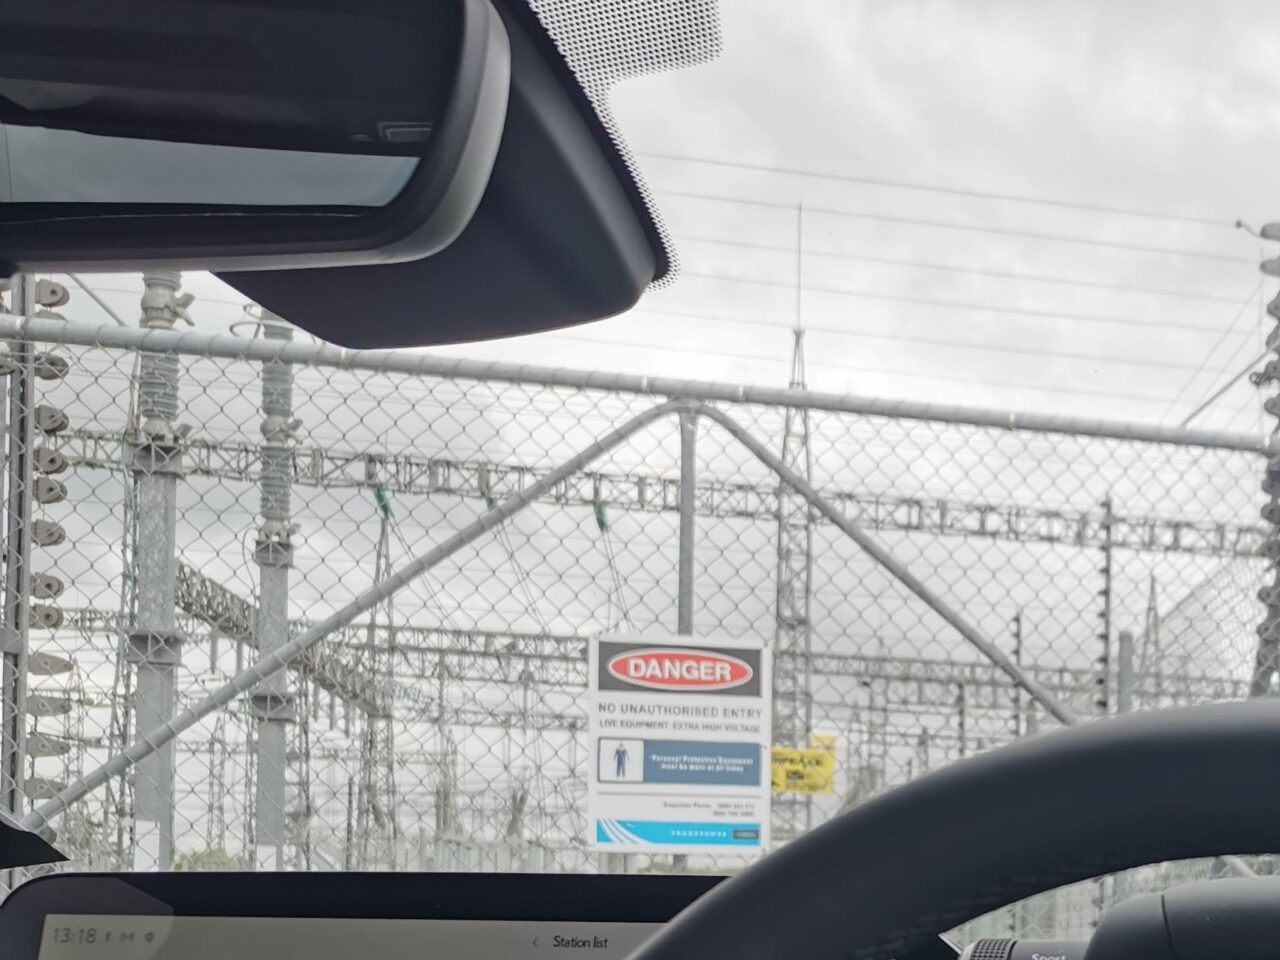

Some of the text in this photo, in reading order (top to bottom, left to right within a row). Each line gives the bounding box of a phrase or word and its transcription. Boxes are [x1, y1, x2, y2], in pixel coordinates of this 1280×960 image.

[628, 657, 732, 682] DANGER
[598, 702, 762, 719] NO UNAUTHORISED ENTRY
[599, 719, 617, 728] LIVE
[673, 722, 699, 731] EXTRA
[724, 724, 761, 734] VOLTAGE
[53, 927, 97, 944] 13:18
[553, 935, 609, 949] Station list
